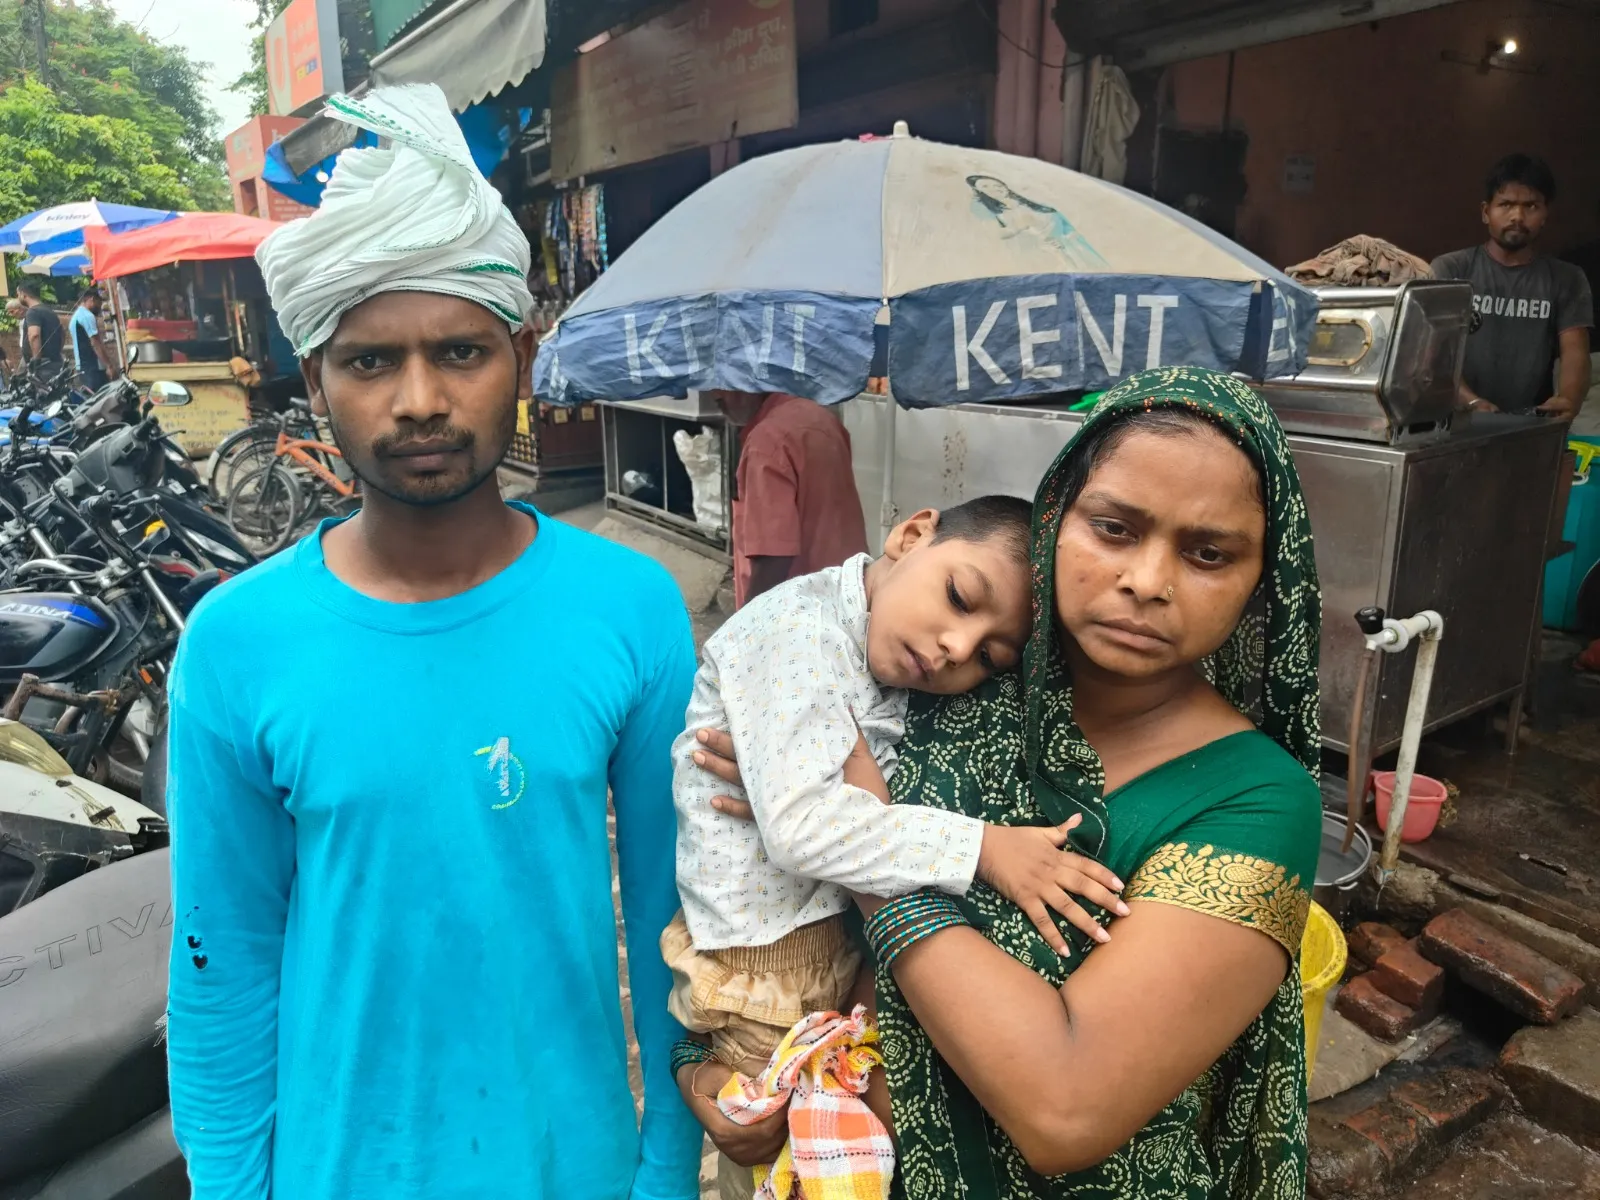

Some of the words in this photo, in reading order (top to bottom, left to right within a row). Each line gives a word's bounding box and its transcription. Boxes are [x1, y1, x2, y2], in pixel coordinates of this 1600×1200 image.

[624, 302, 817, 385] KENT
[952, 291, 1179, 391] KENT
[1472, 294, 1551, 318] SQUARED
